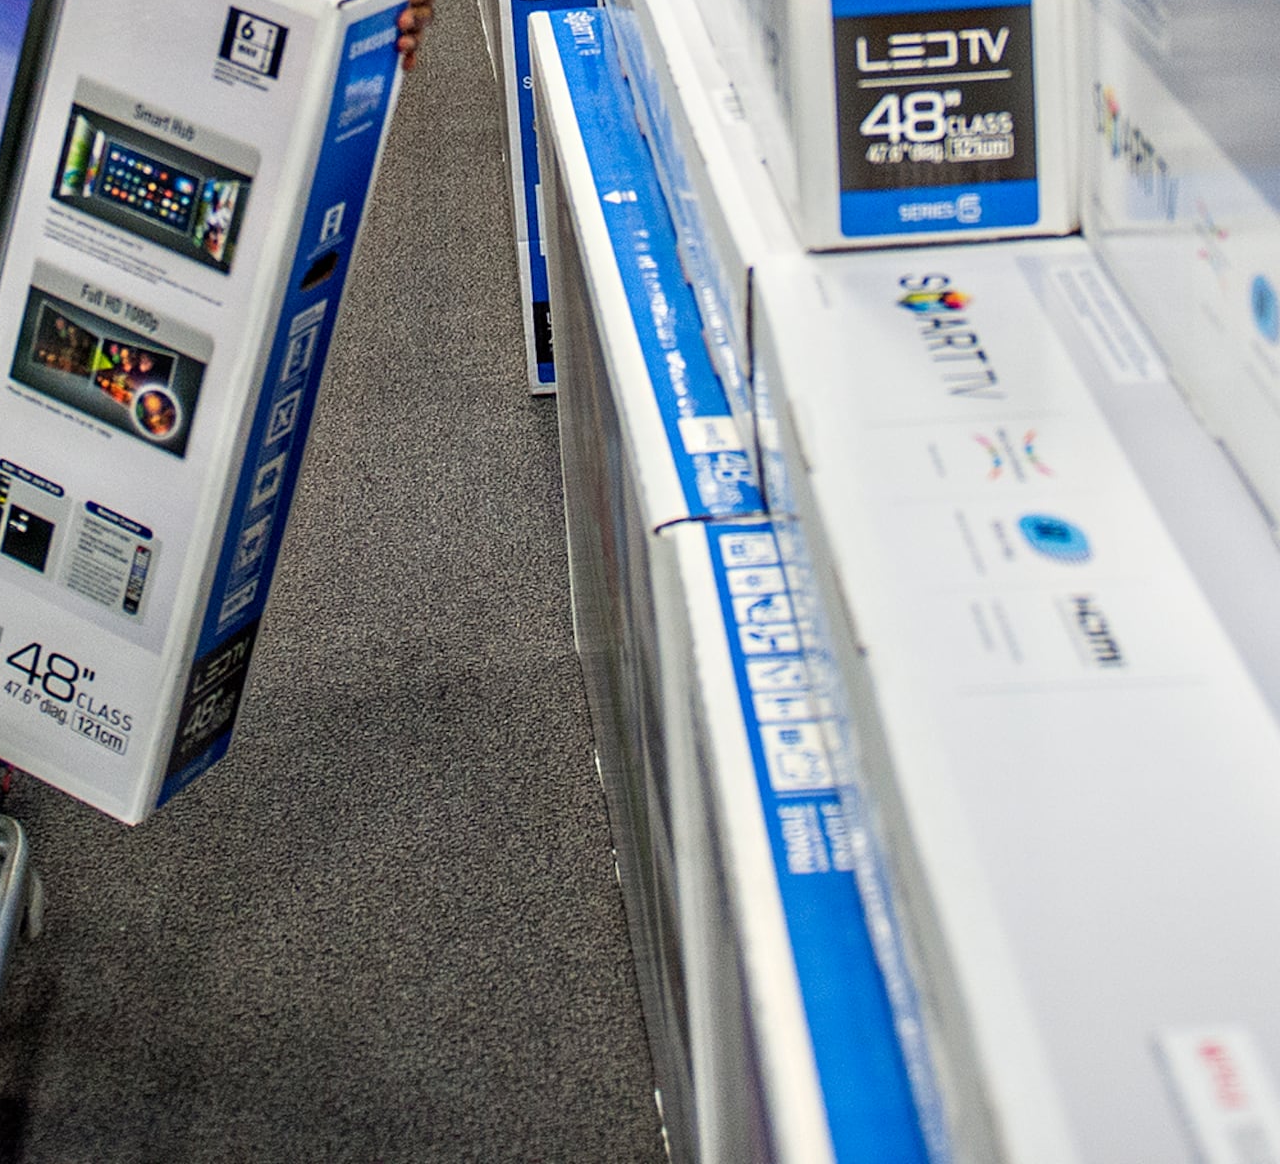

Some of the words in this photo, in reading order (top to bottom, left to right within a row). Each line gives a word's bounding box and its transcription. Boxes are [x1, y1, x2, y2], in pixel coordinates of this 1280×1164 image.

[241, 20, 255, 40] 6
[856, 30, 958, 73] LED
[957, 27, 1010, 65] TV
[132, 101, 169, 132] Smart
[170, 114, 195, 143] Hub
[859, 90, 962, 143] 48"
[947, 111, 1014, 135] CLASS
[79, 282, 102, 306] Full
[103, 290, 122, 312] HD
[123, 298, 161, 333] 1080p
[6, 641, 97, 702] 48"
[76, 692, 134, 732] CLASS
[3, 679, 41, 708] 47.6"
[75, 712, 125, 752] 121cm
